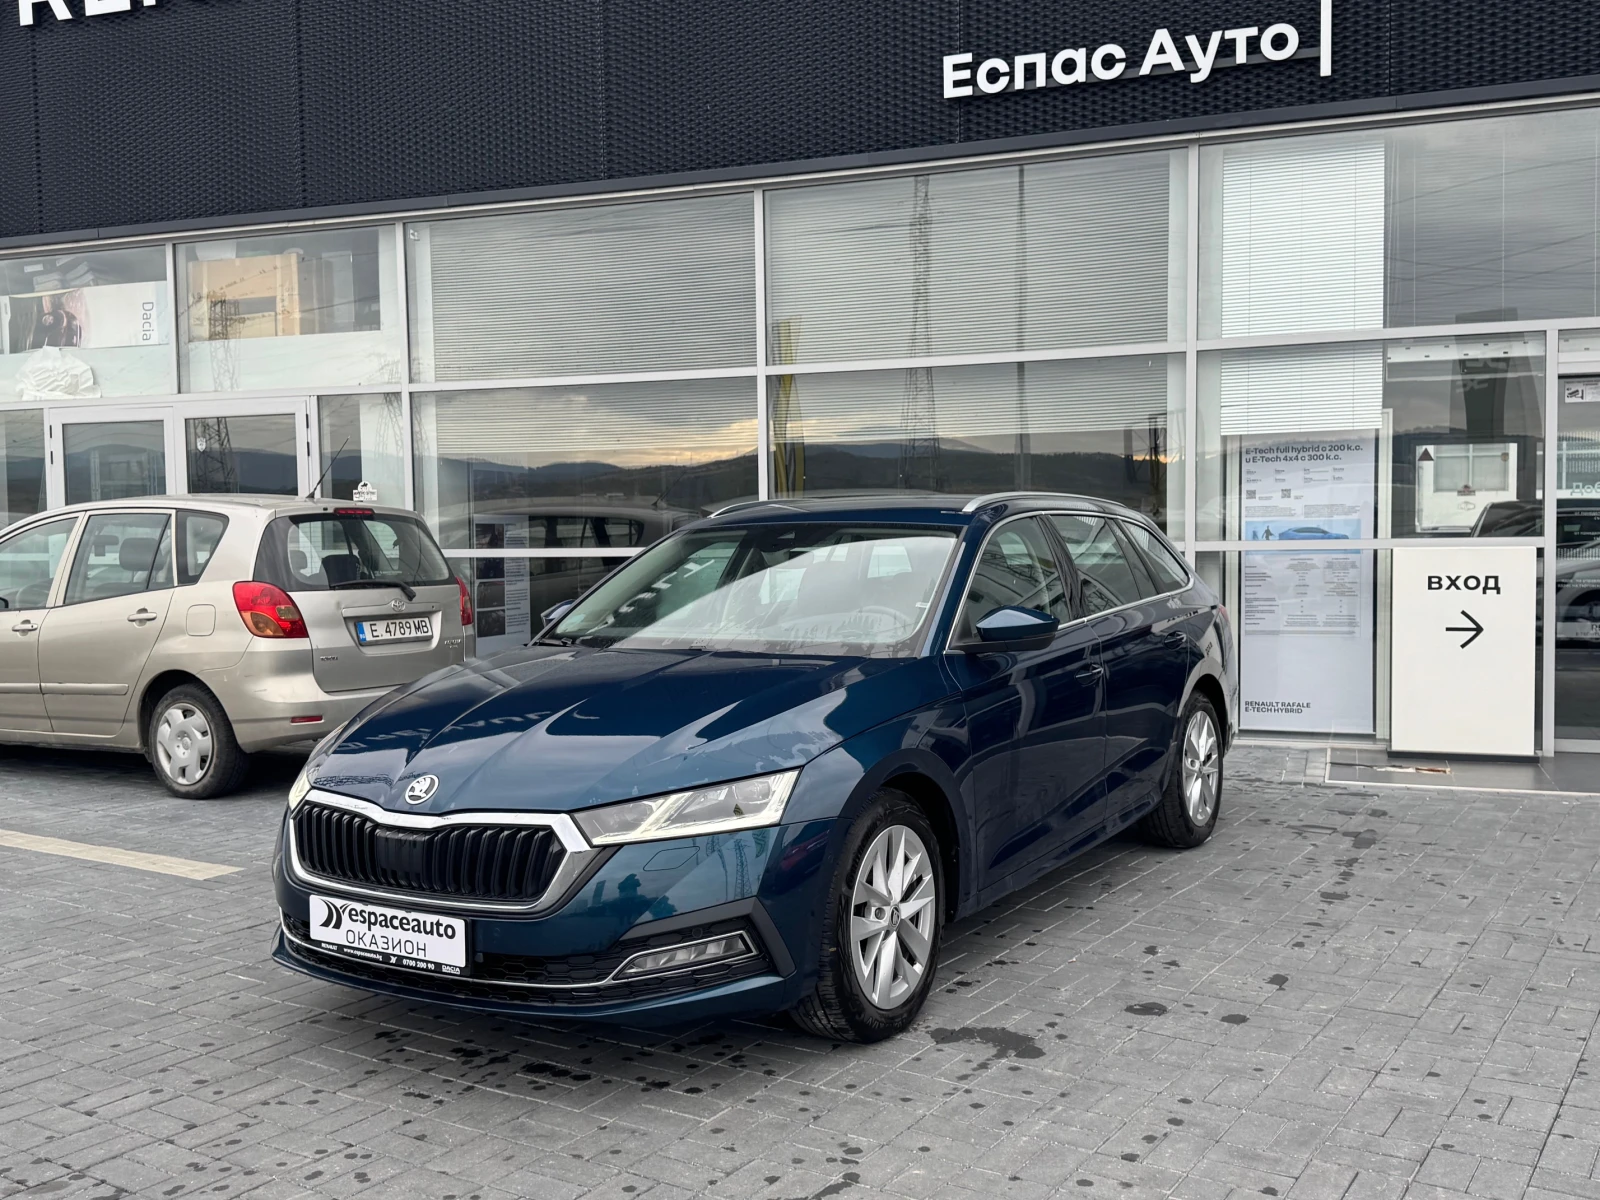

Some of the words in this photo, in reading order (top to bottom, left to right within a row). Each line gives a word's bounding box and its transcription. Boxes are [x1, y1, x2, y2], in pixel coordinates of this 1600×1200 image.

[943, 43, 1126, 99] Еспас
[1139, 23, 1300, 83] Ауто
[142, 301, 155, 341] Dacia
[1245, 446, 1275, 455] E-Tech
[1276, 445, 1290, 454] full
[1291, 443, 1320, 455] hybrid
[1328, 444, 1346, 452] 200
[1252, 454, 1281, 463] E-Tech
[1307, 454, 1325, 462] 300
[385, 618, 412, 636] 4789
[413, 619, 429, 634] MB
[1244, 700, 1281, 708] RENAULT
[348, 907, 456, 940] espaceauto
[346, 929, 427, 958] ОКАЗИОН
[343, 947, 383, 961] www.espaceauto.bg
[402, 958, 416, 967] 0700
[416, 961, 427, 970] 200
[427, 963, 435, 971] 90
[441, 964, 460, 973] DACIA
